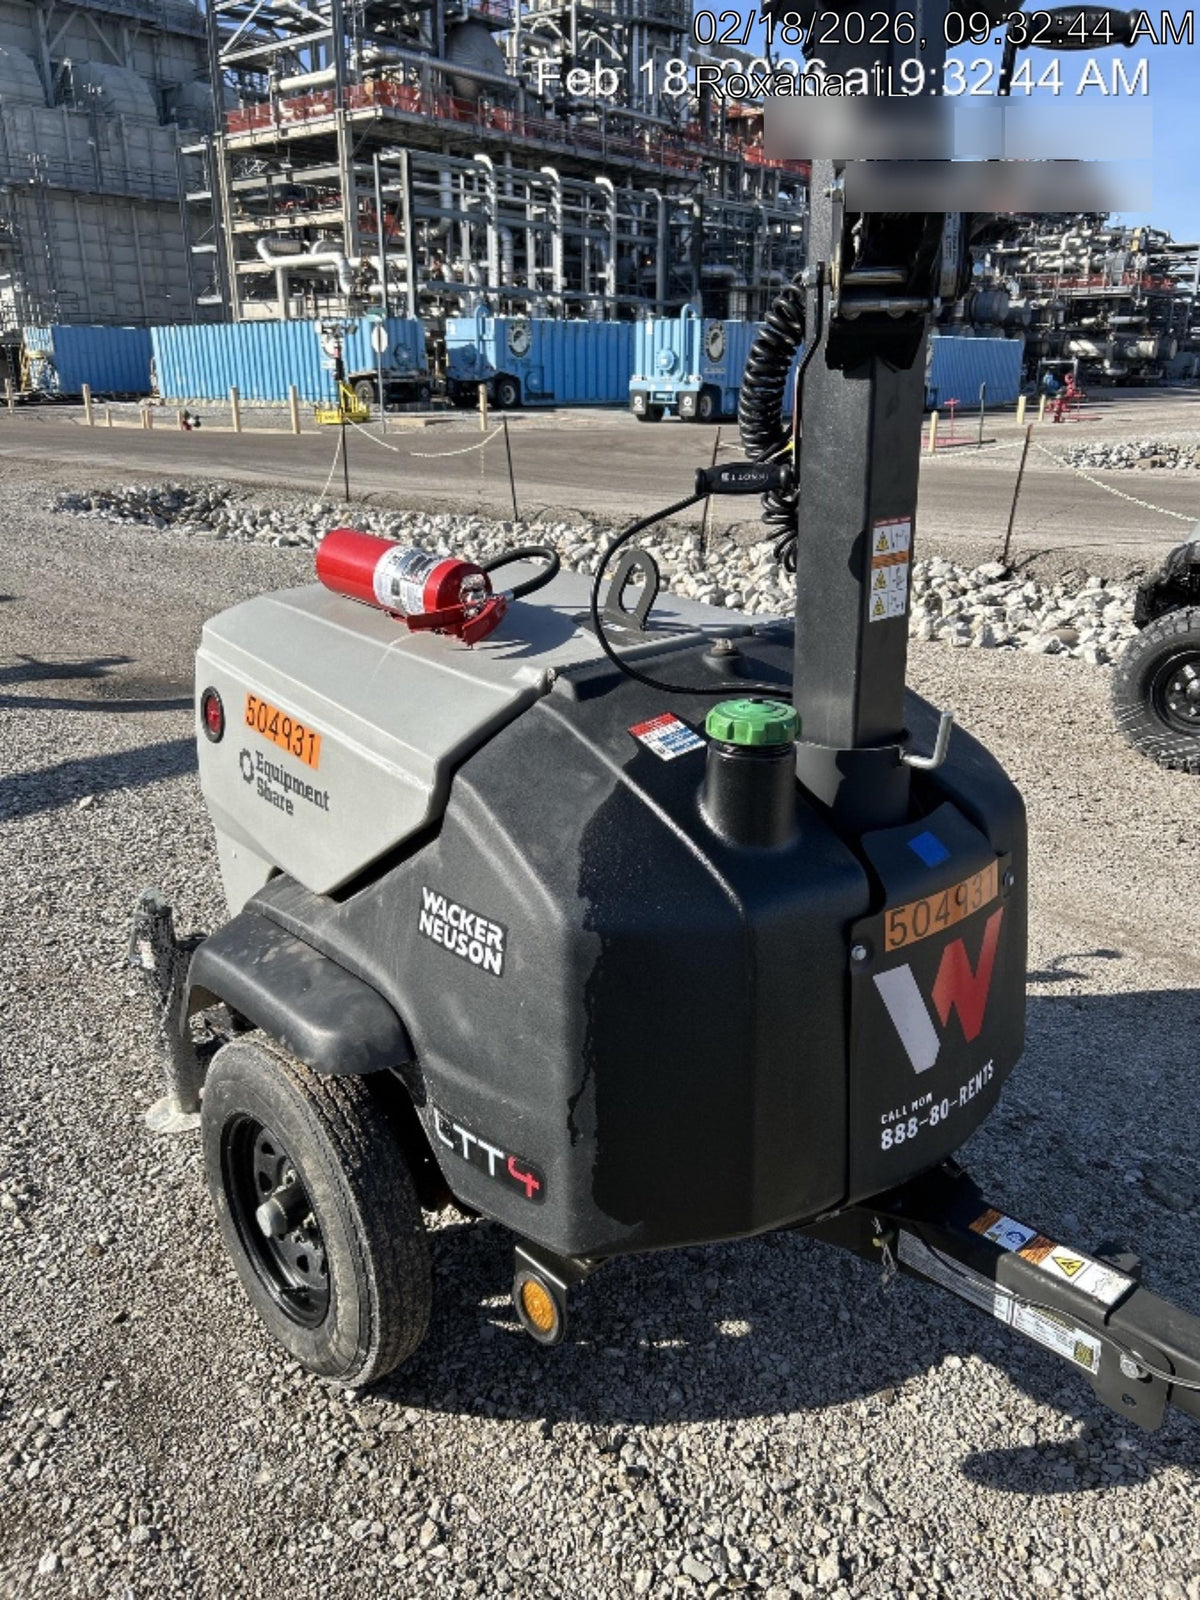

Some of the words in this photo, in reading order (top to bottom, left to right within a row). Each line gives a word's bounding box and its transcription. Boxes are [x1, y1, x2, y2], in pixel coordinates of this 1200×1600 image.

[246, 696, 317, 765] 504931
[255, 750, 330, 812] Equipment
[256, 779, 295, 816] Share
[422, 886, 504, 952] WACKER
[889, 868, 994, 947] 504931
[419, 909, 502, 975] NEUSON
[881, 1059, 994, 1150] 888-80-RENTS
[881, 1105, 907, 1124] CALL
